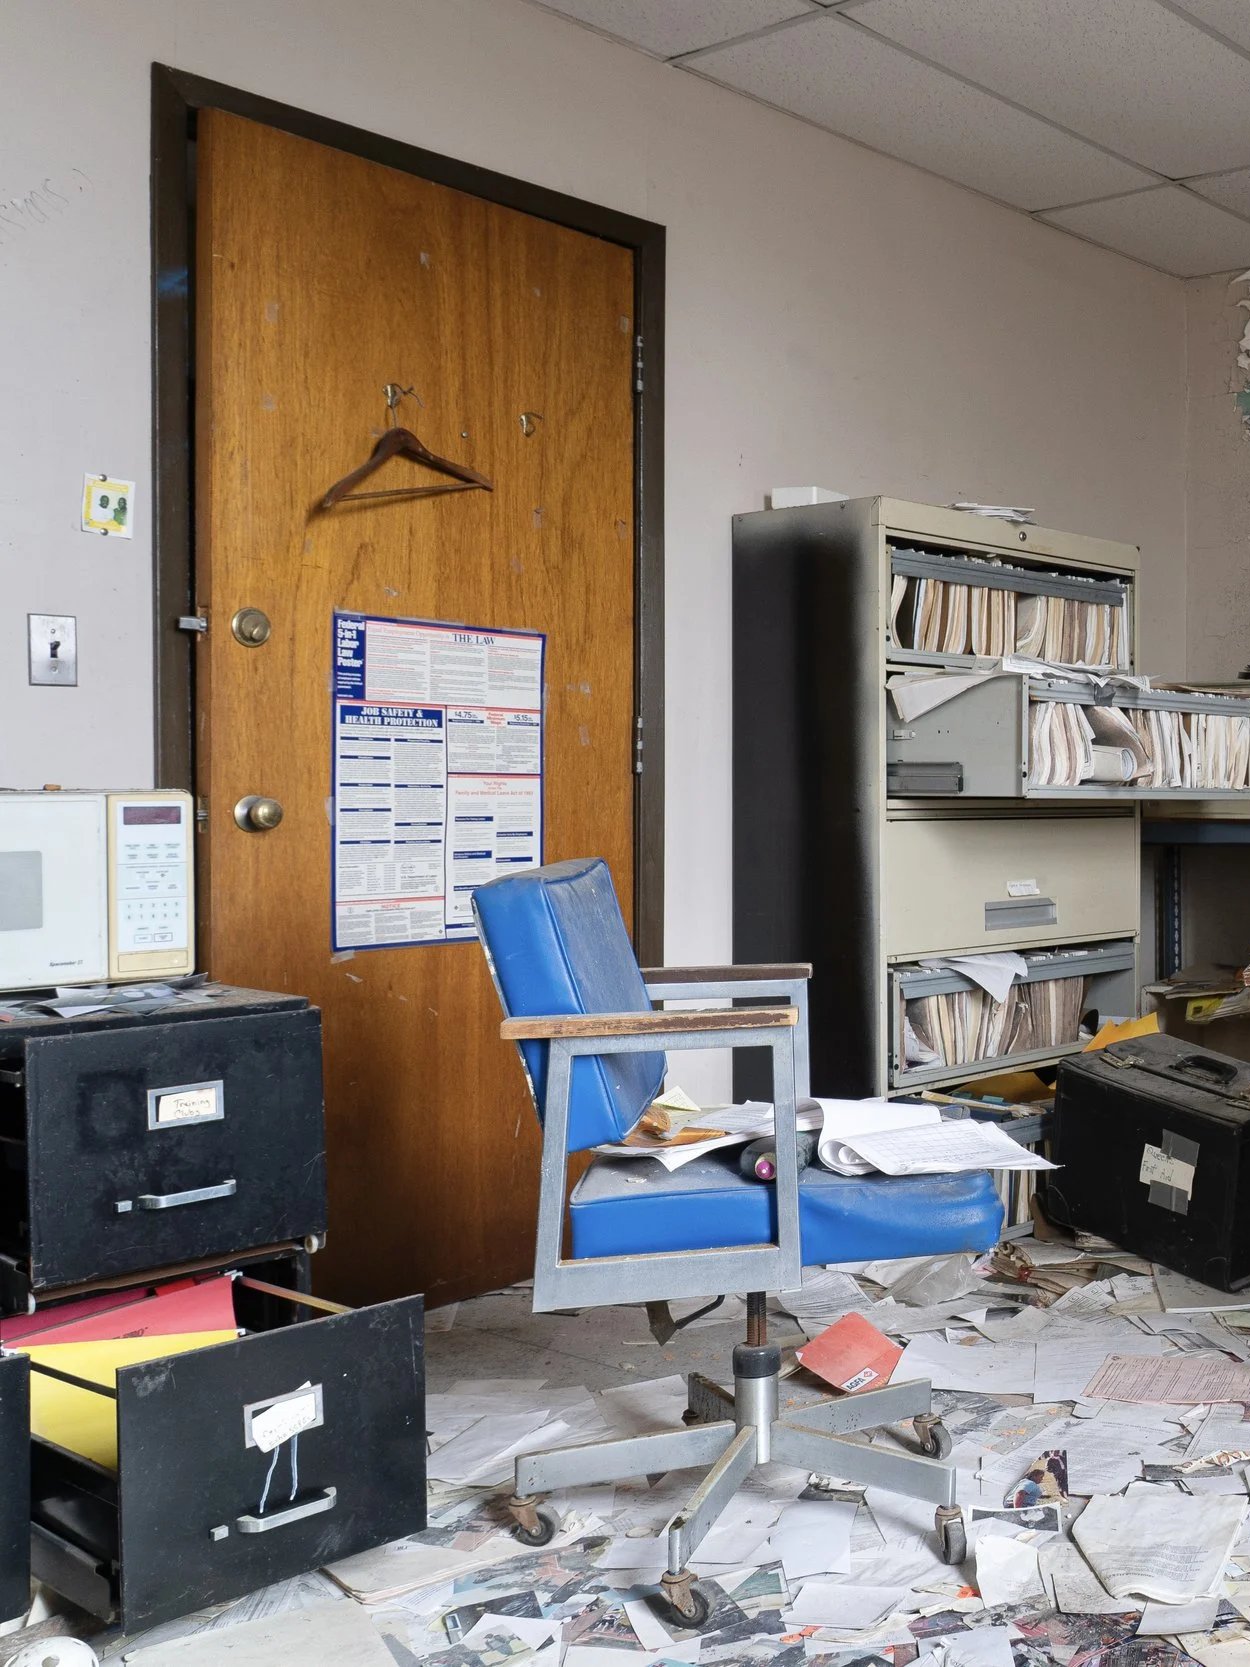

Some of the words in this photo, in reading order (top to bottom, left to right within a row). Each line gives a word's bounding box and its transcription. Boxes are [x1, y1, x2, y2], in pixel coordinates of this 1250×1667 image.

[337, 619, 366, 631] Federal
[452, 633, 475, 644] THE
[475, 635, 496, 646] LAW
[337, 647, 354, 658] Law
[337, 656, 363, 668] Poster
[361, 706, 380, 716] JOB
[381, 708, 415, 718] SAFETY
[415, 709, 424, 718] &
[344, 715, 382, 725] HEALTH
[384, 717, 440, 728] PROTECTION
[173, 1098, 212, 1109] Training
[1160, 1168, 1175, 1182] Aid
[845, 1377, 866, 1390] AGFA
